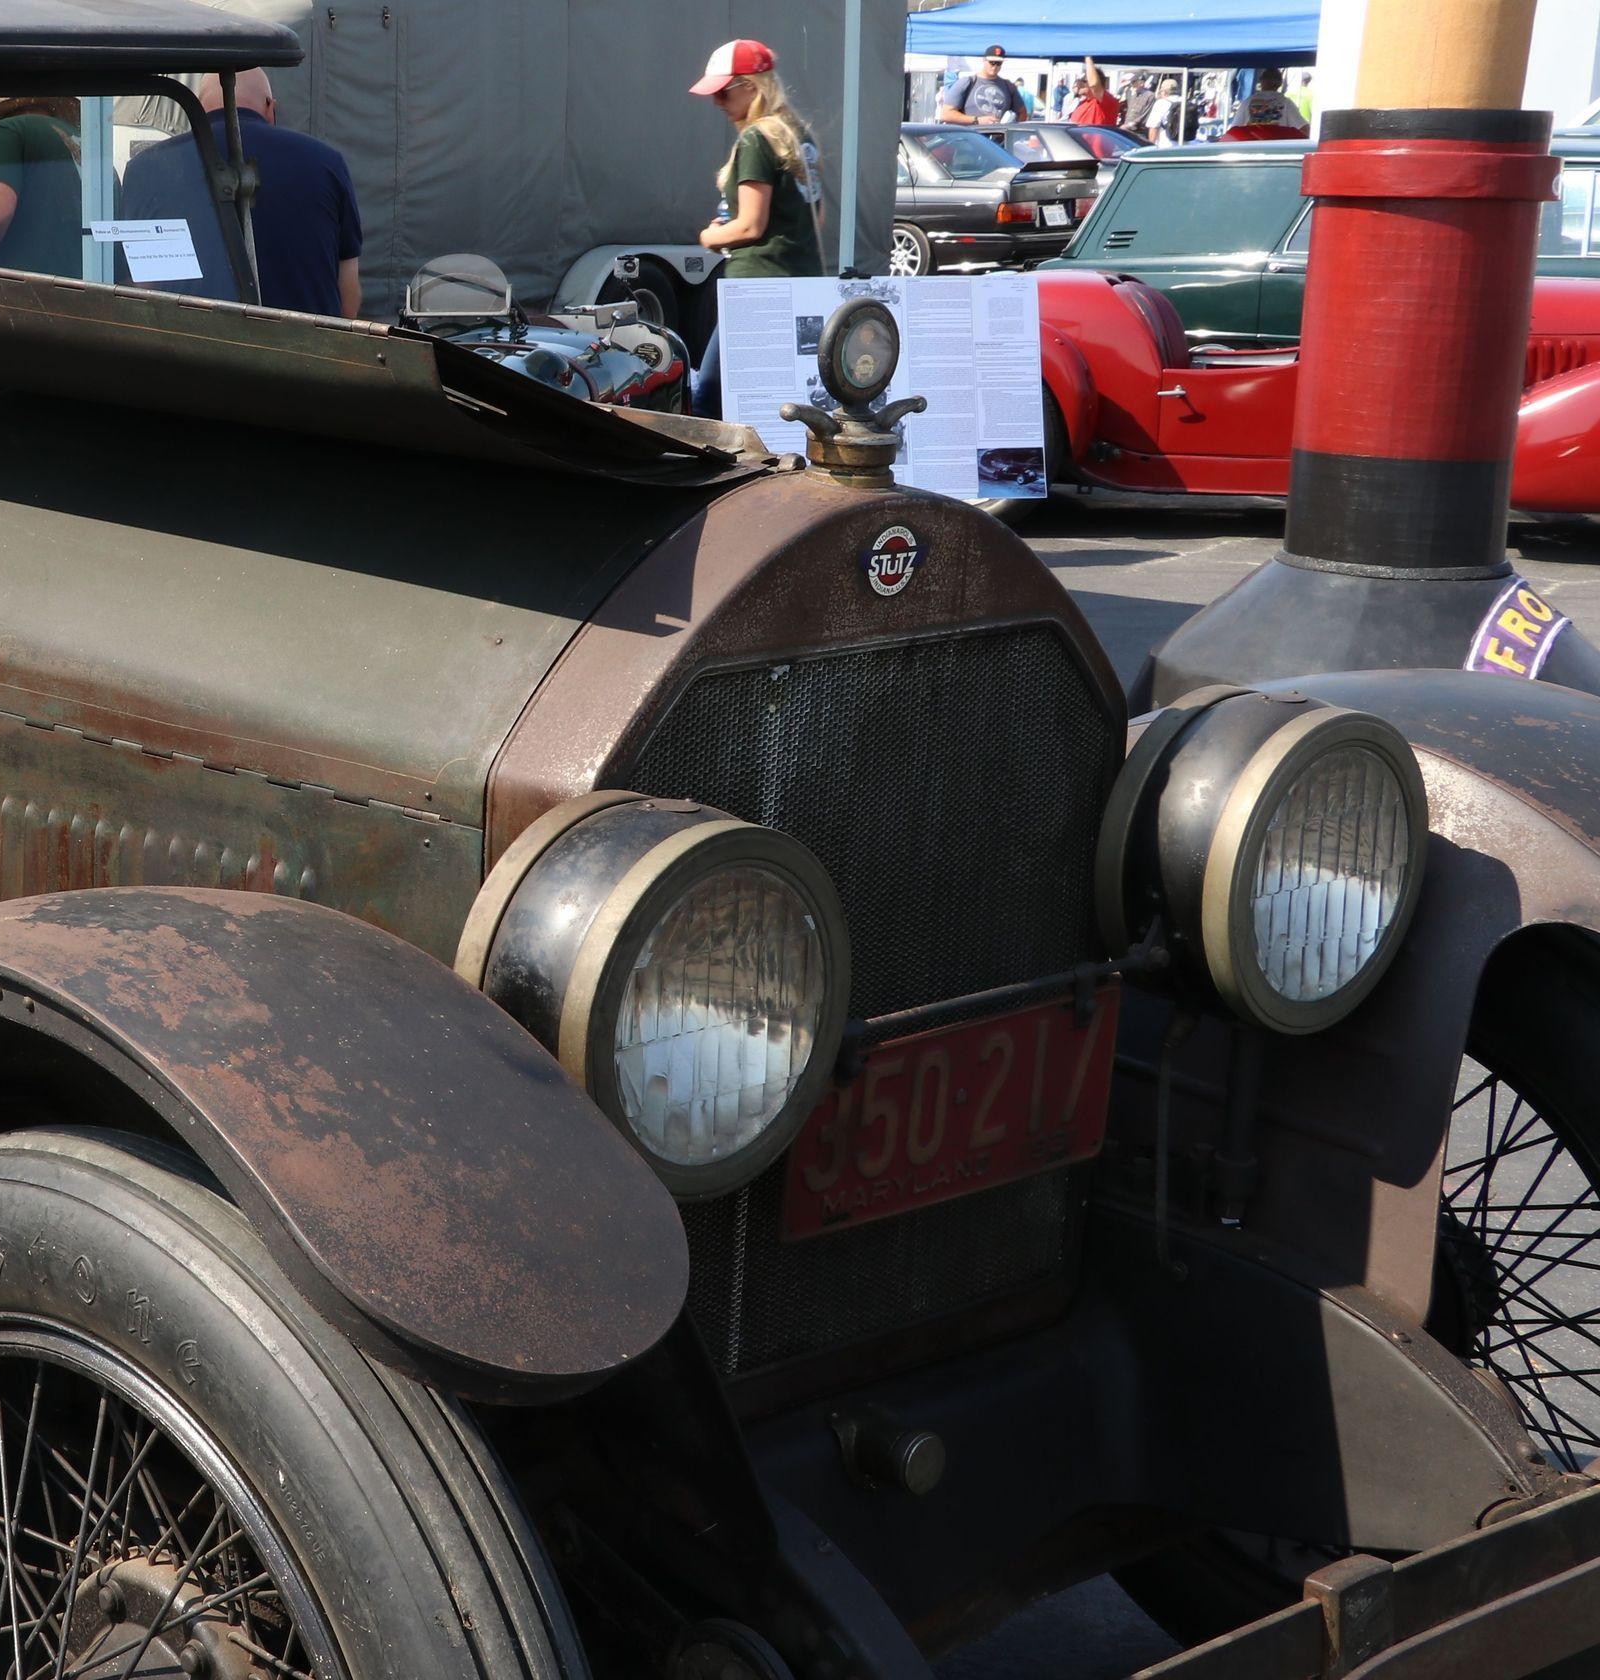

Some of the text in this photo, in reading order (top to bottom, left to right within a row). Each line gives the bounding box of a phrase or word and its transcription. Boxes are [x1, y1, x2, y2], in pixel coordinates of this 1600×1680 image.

[868, 551, 918, 577] STUTZ
[1484, 589, 1553, 674] FRO
[822, 1153, 991, 1212] MARYLAND
